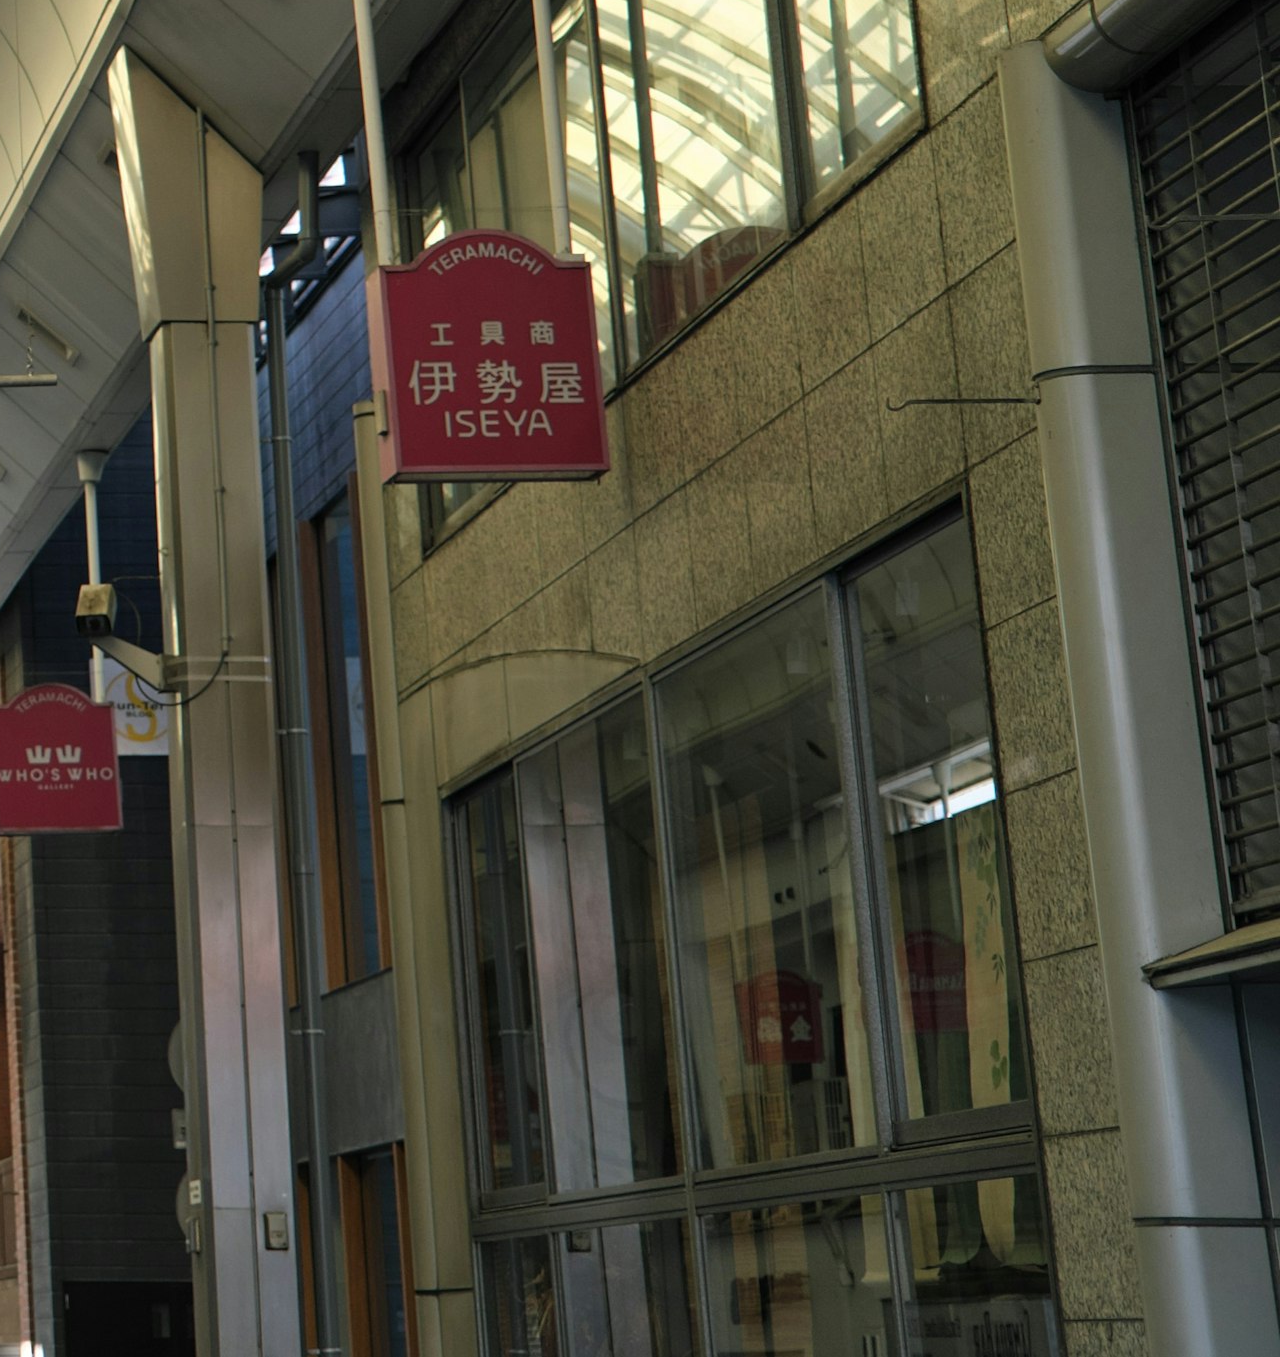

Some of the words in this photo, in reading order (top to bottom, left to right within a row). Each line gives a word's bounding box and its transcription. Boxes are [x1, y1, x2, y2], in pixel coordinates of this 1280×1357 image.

[428, 242, 544, 276] TERAMACHI
[430, 320, 555, 346] 工具商
[408, 359, 585, 405] 伊勢屋
[444, 409, 553, 438] ISEYA
[15, 692, 87, 713] TERAMACHI
[67, 766, 114, 781] WHO
